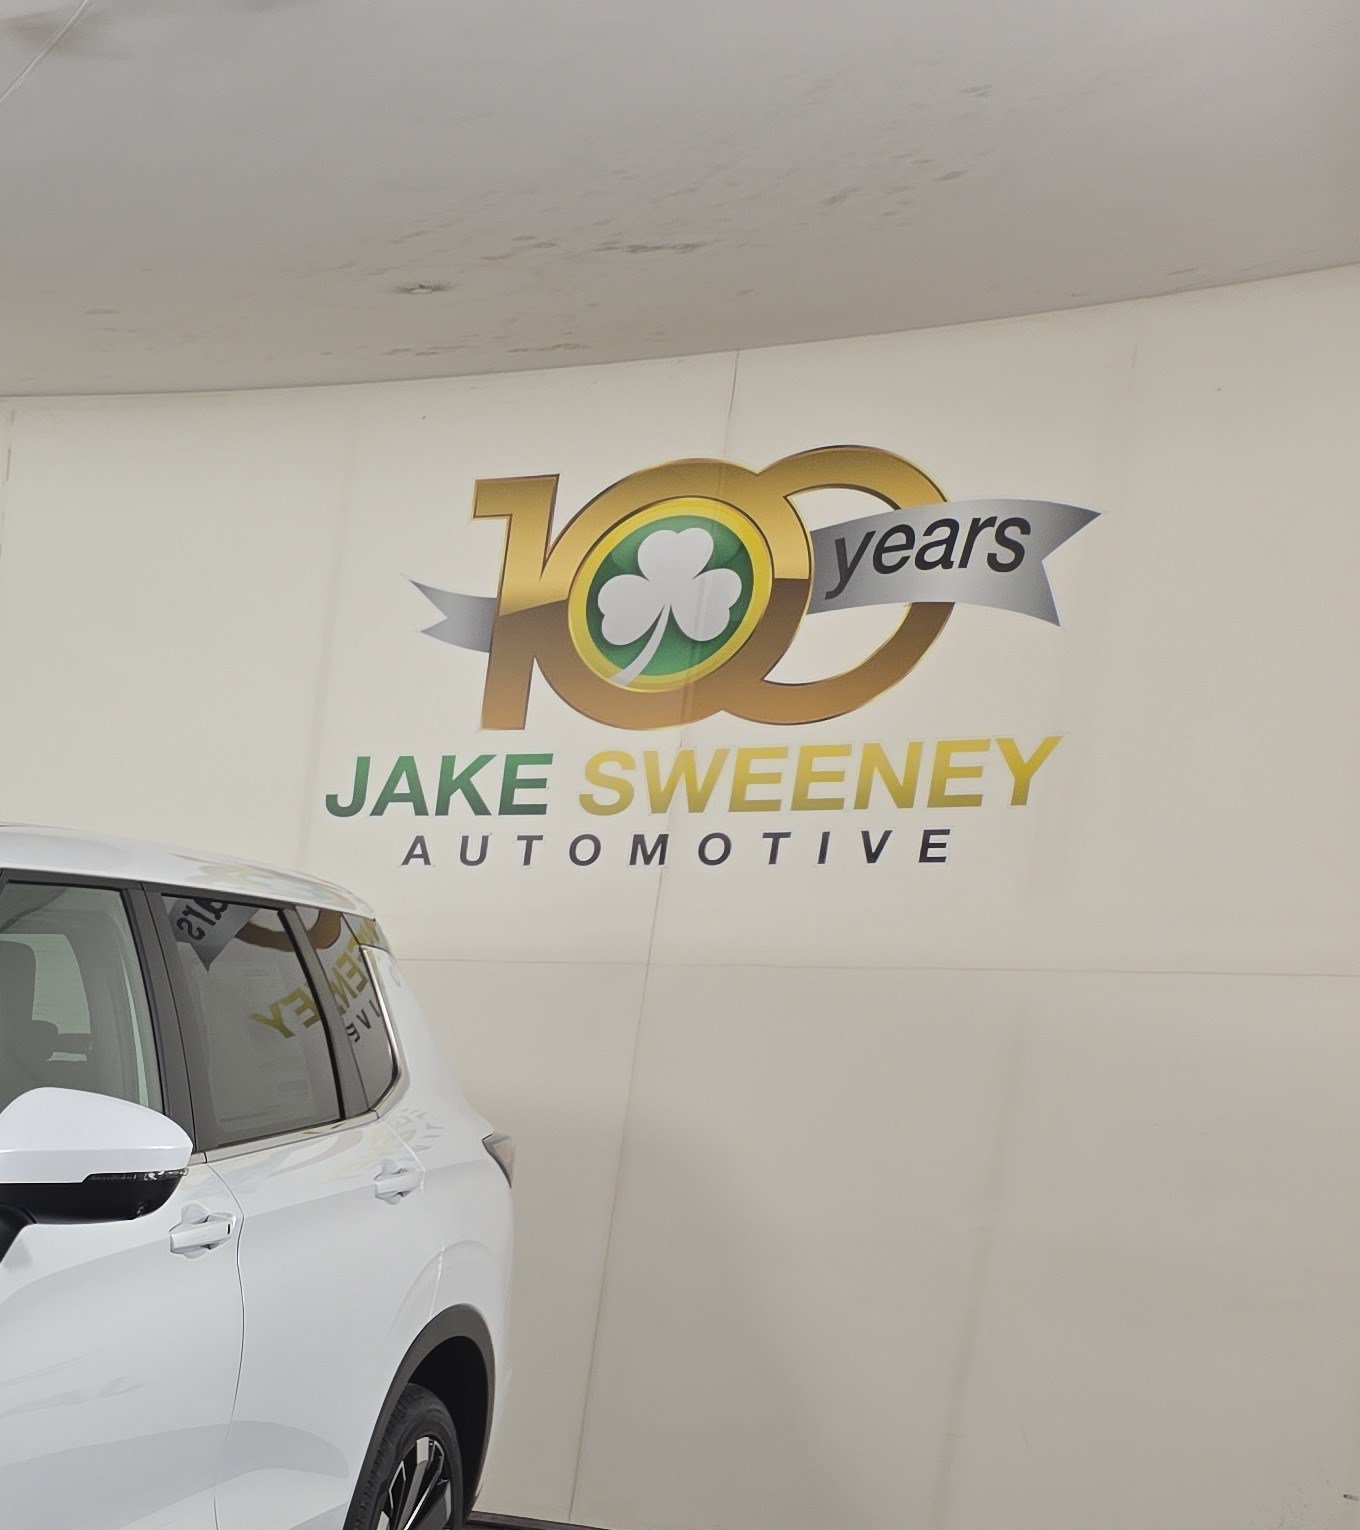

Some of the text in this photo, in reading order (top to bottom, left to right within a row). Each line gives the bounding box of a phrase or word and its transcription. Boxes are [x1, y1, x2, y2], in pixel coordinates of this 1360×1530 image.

[473, 444, 1031, 731] 100 years
[324, 734, 1063, 819] JAKE SWEENEY
[401, 828, 952, 867] AUTOMOTIVE
